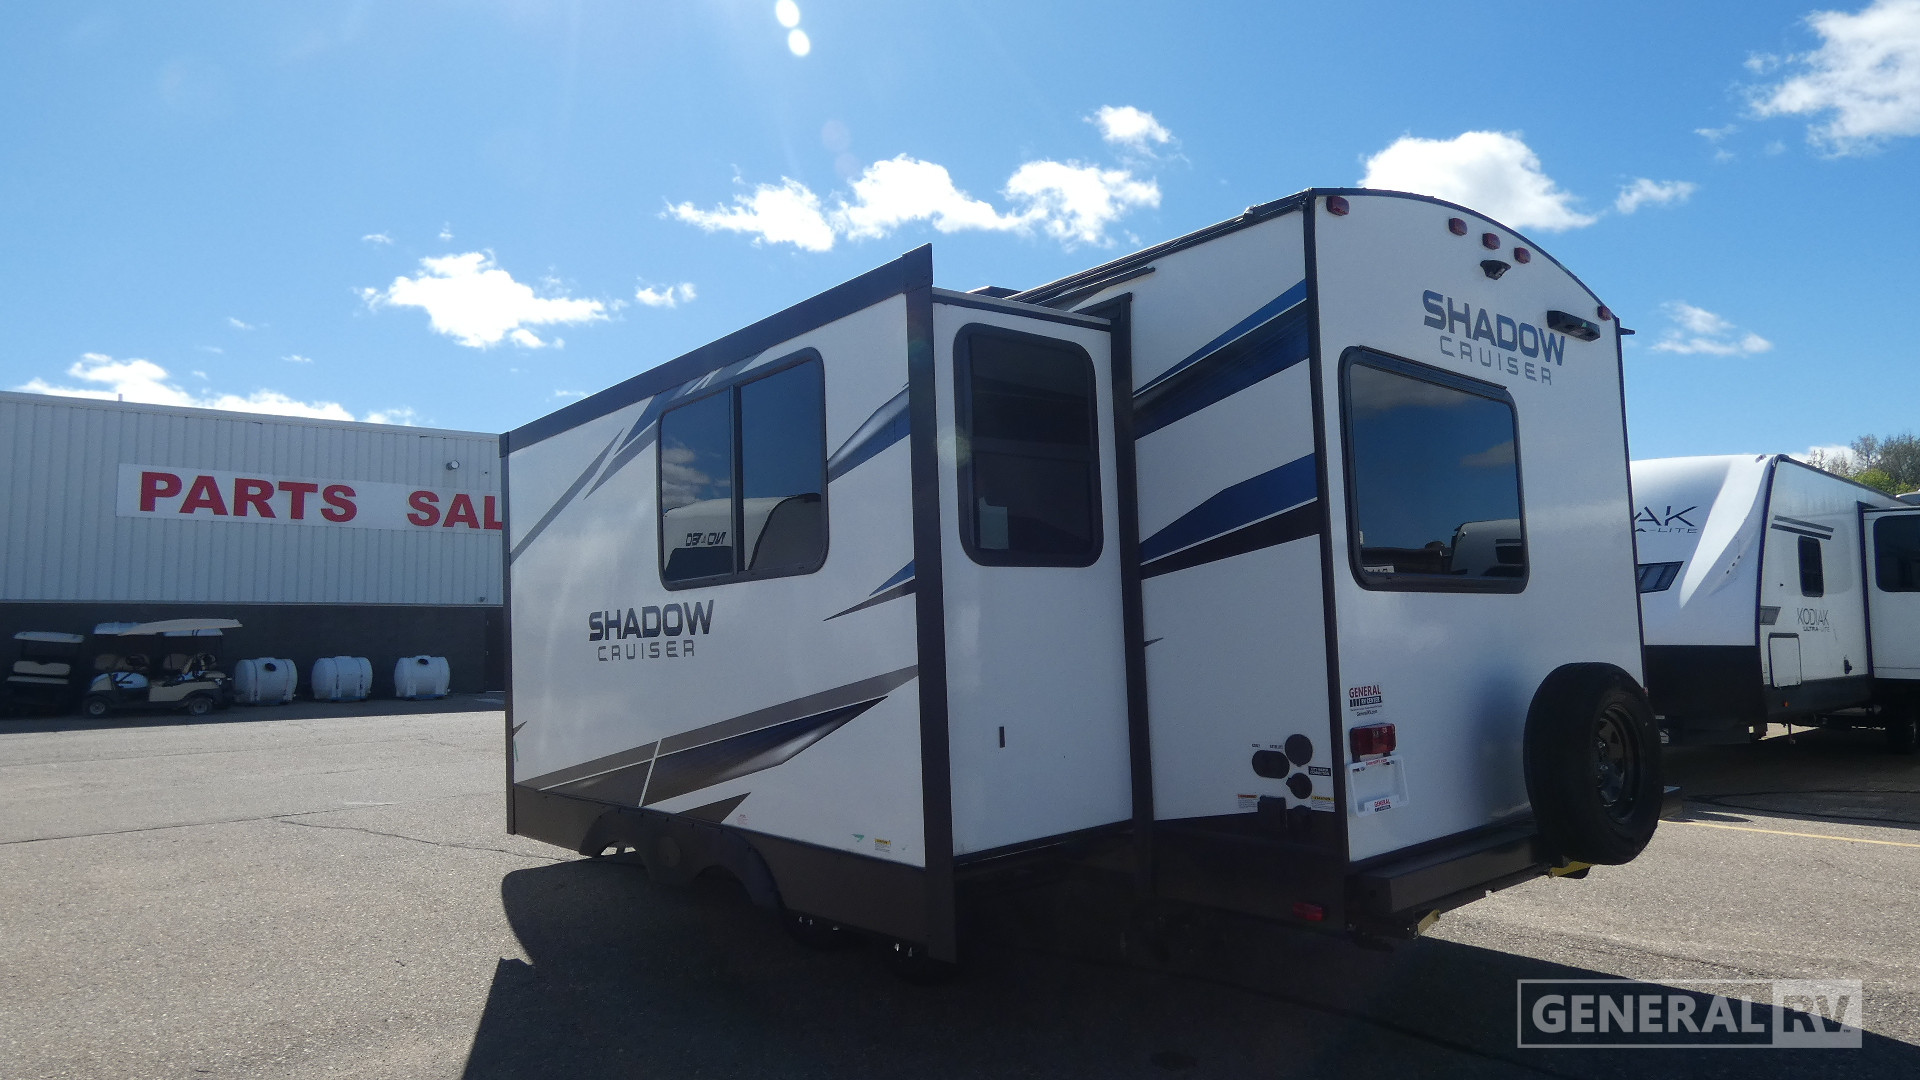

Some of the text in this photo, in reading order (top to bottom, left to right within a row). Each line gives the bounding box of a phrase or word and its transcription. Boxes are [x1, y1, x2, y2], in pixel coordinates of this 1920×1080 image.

[1422, 289, 1566, 366] SHADOW
[1439, 335, 1552, 386] CRUISER
[139, 471, 358, 522] PARTS
[588, 599, 714, 641] SHADOW
[1796, 607, 1830, 626] KODIAK
[597, 639, 695, 662] CRUISER
[1348, 684, 1382, 698] GENERAL
